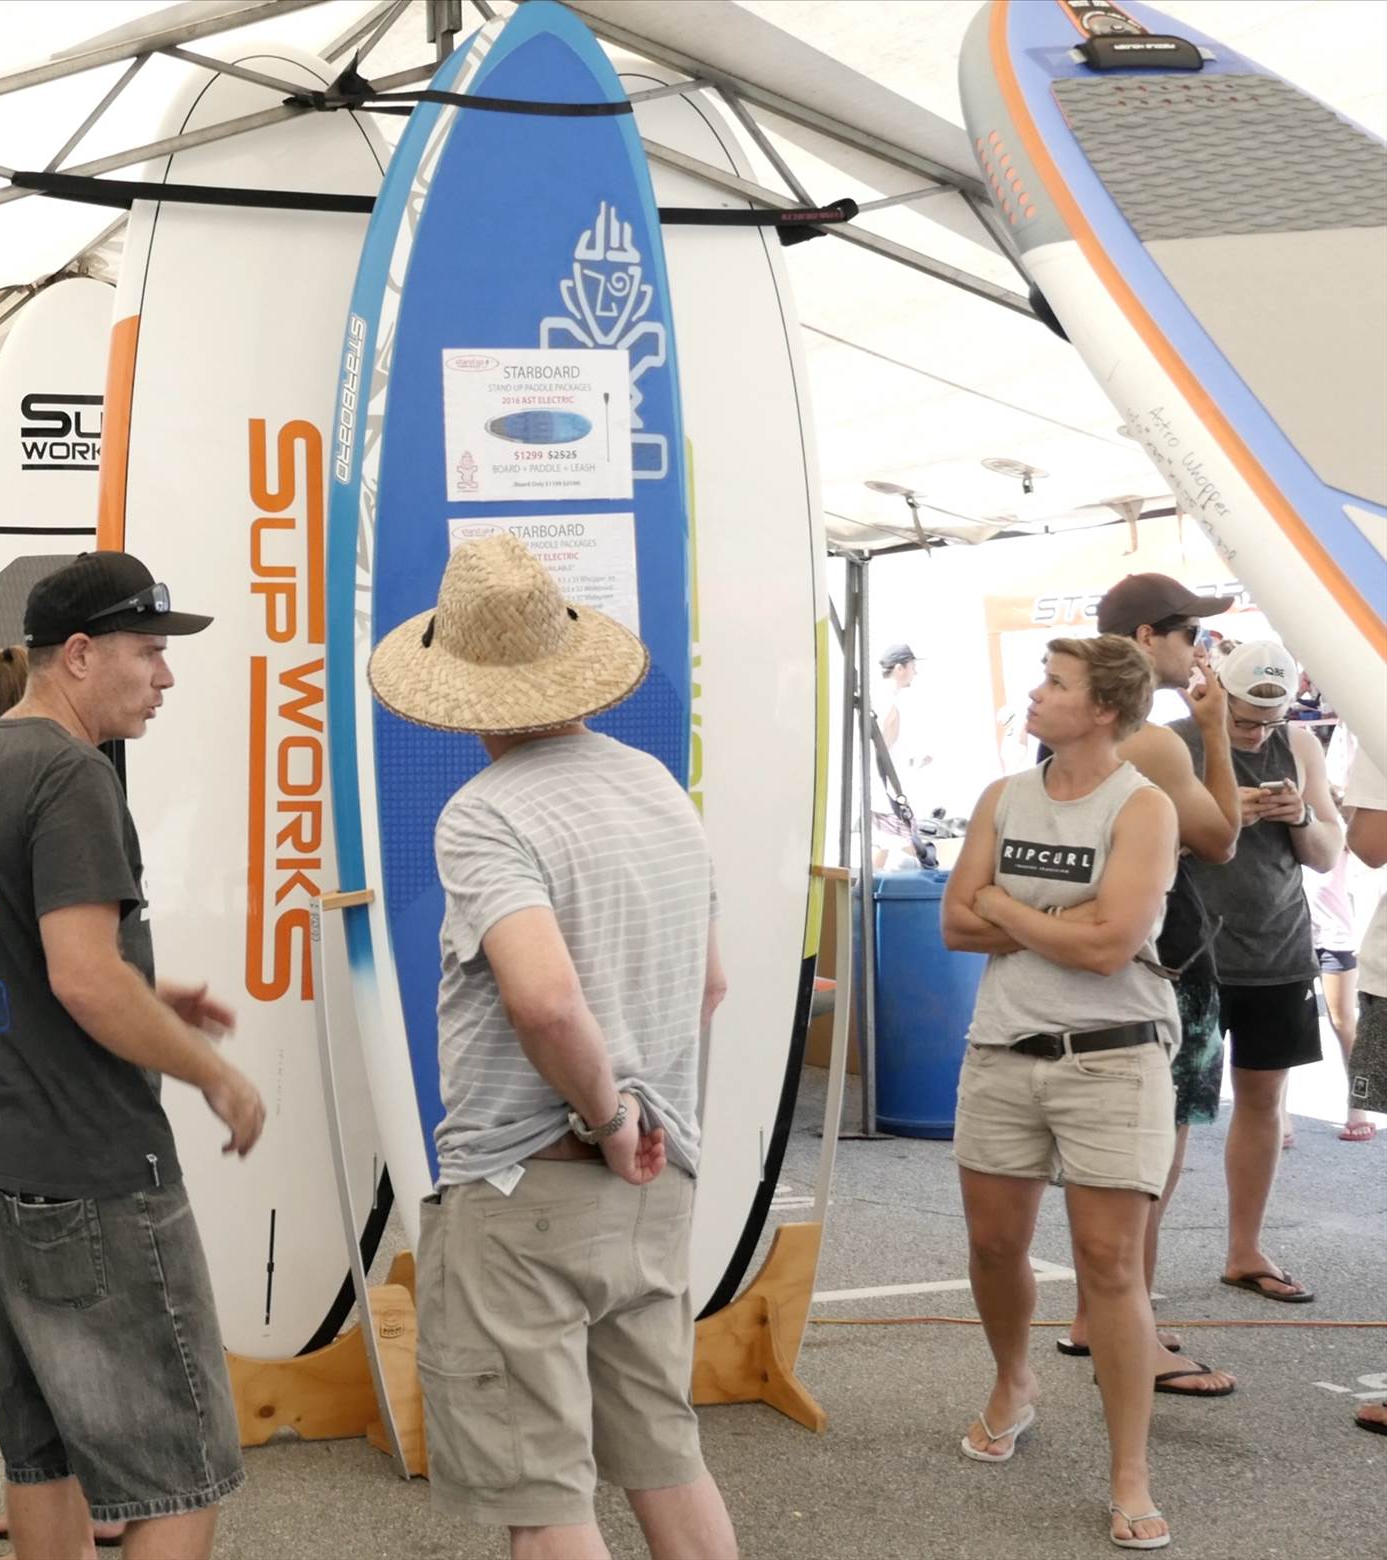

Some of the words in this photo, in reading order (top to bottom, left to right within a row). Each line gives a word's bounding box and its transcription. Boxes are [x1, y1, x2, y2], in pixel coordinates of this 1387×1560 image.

[503, 366, 581, 380] STARBOARD
[488, 383, 512, 392] STAND
[513, 383, 525, 392] UP
[525, 383, 554, 392] PADDLE
[555, 382, 591, 392] PACKAGES
[502, 396, 519, 405] 2016
[522, 396, 536, 405] AST
[538, 395, 574, 404] ELECTRIC
[21, 393, 104, 438] SU
[21, 441, 101, 460] WORK
[514, 451, 543, 461] $1299
[492, 464, 521, 474] BOARD
[529, 464, 561, 473] PADDLE
[570, 463, 596, 472] LEASH
[1148, 406, 1180, 448] Astro
[1181, 451, 1231, 517] Whopper
[248, 418, 325, 644] SUP
[508, 523, 585, 539] STARBOARD
[560, 539, 597, 549] PACKAGES
[543, 552, 580, 561] ELECTRIC
[245, 656, 325, 1002] WORKS
